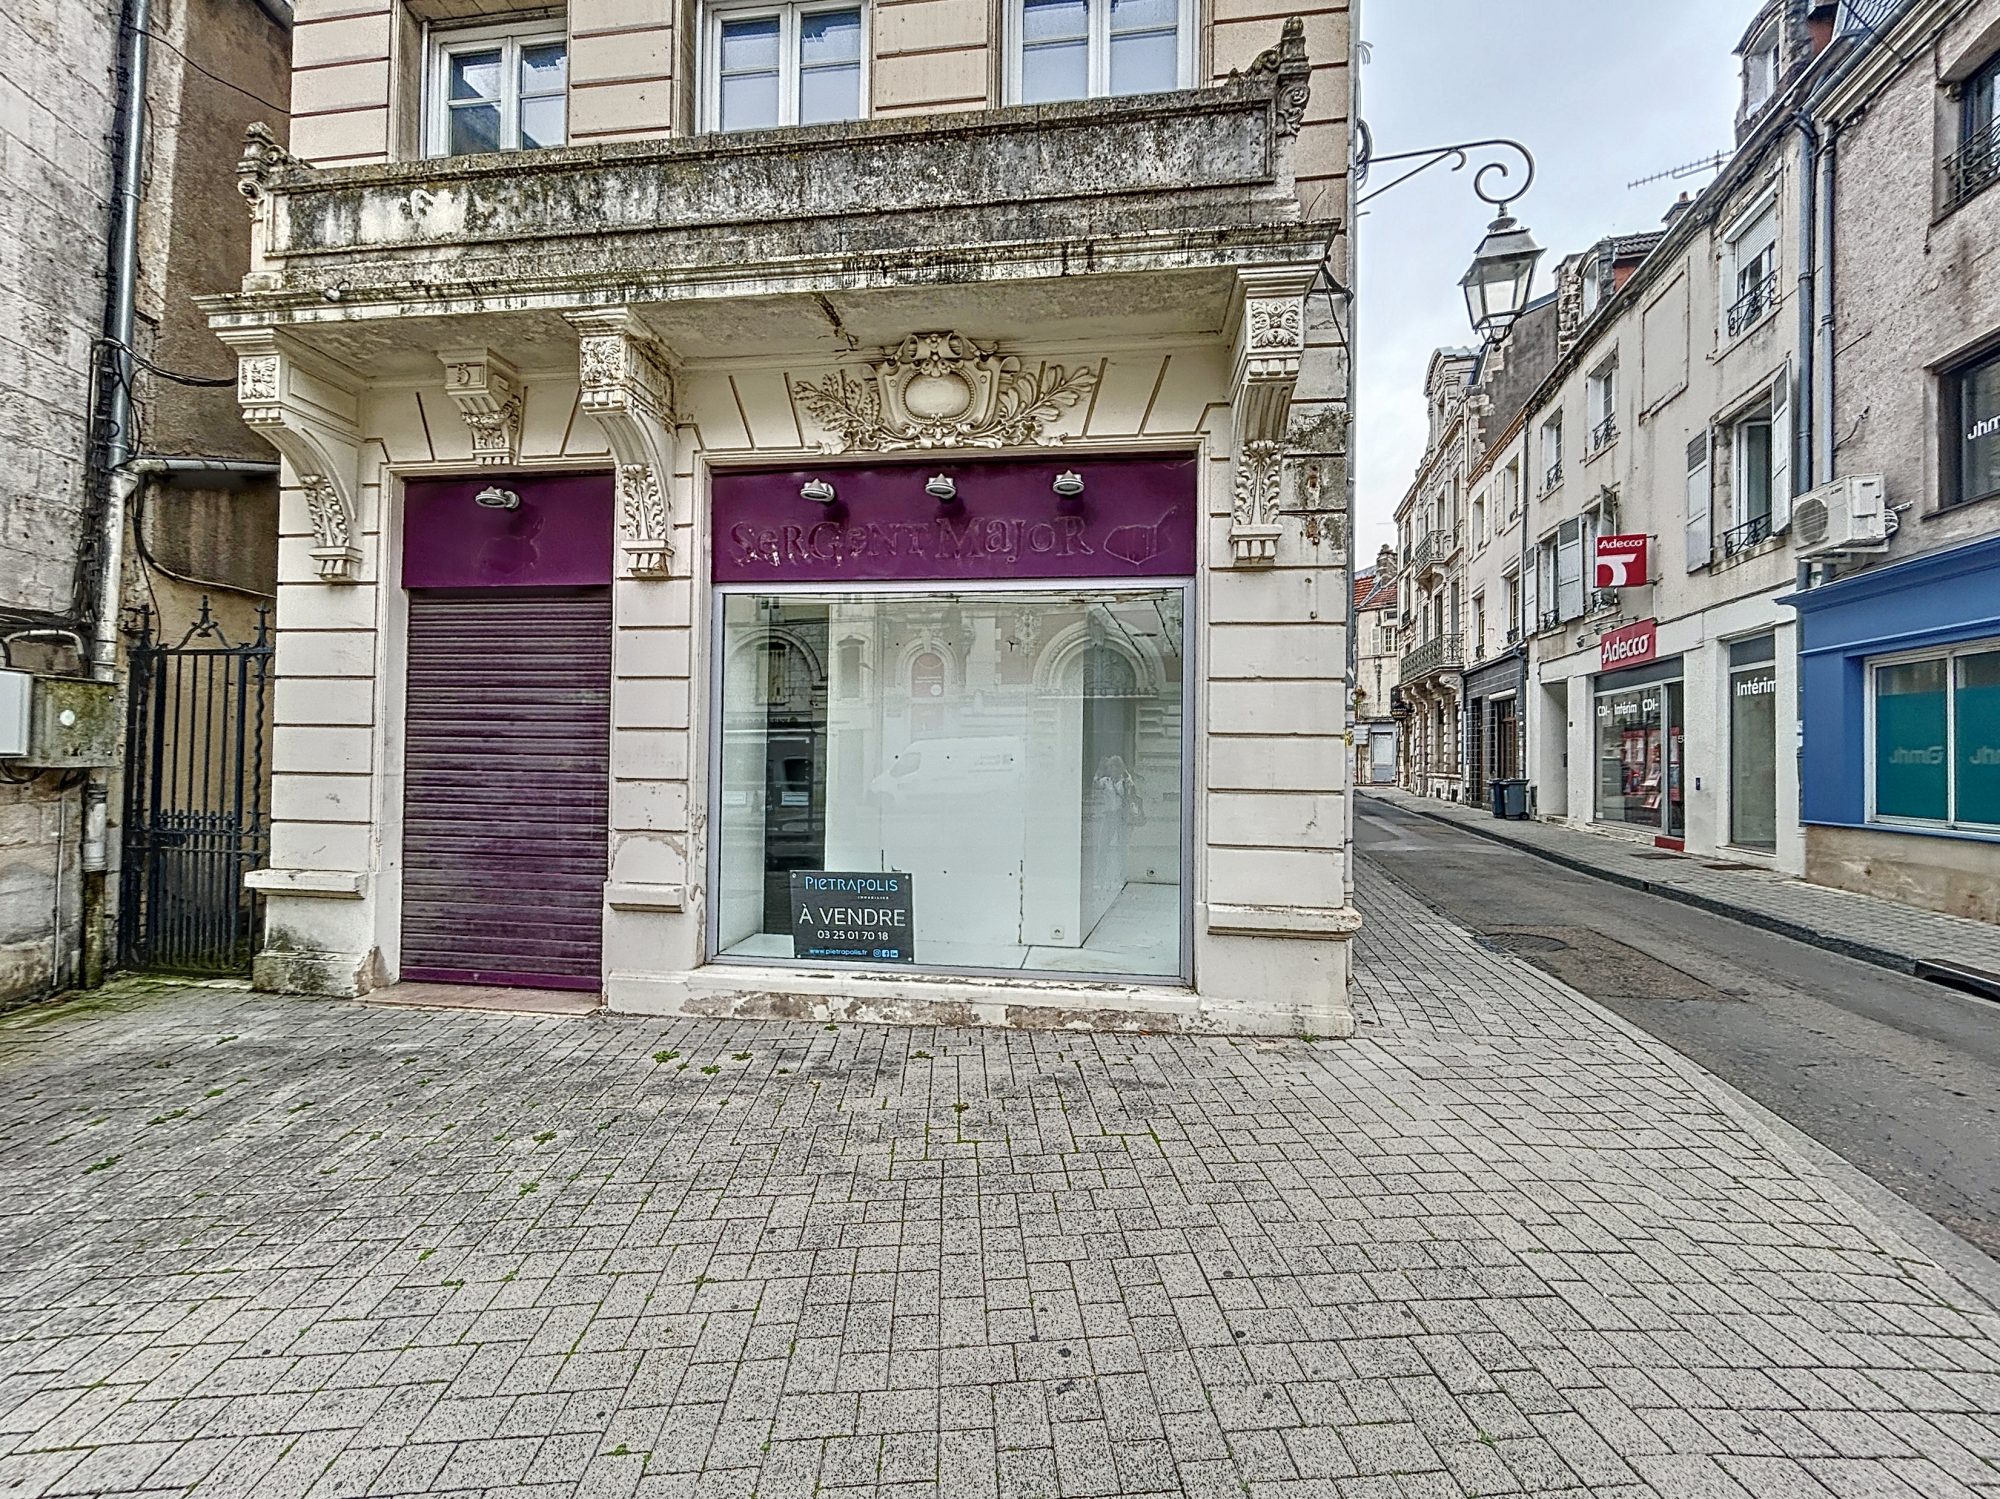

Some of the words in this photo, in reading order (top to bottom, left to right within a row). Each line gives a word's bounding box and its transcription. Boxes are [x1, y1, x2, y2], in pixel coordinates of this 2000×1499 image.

[1598, 538, 1644, 549] Adecco
[1602, 633, 1650, 664] Adecco
[1614, 701, 1638, 715] Intérim
[798, 903, 814, 925] À
[818, 907, 906, 927] VENDRE
[817, 930, 830, 939] 03
[832, 930, 845, 940] 25
[847, 930, 859, 940] 01
[862, 931, 875, 940] 70
[877, 931, 889, 941] 18
[809, 948, 868, 957] www.pietrapolis.fr
